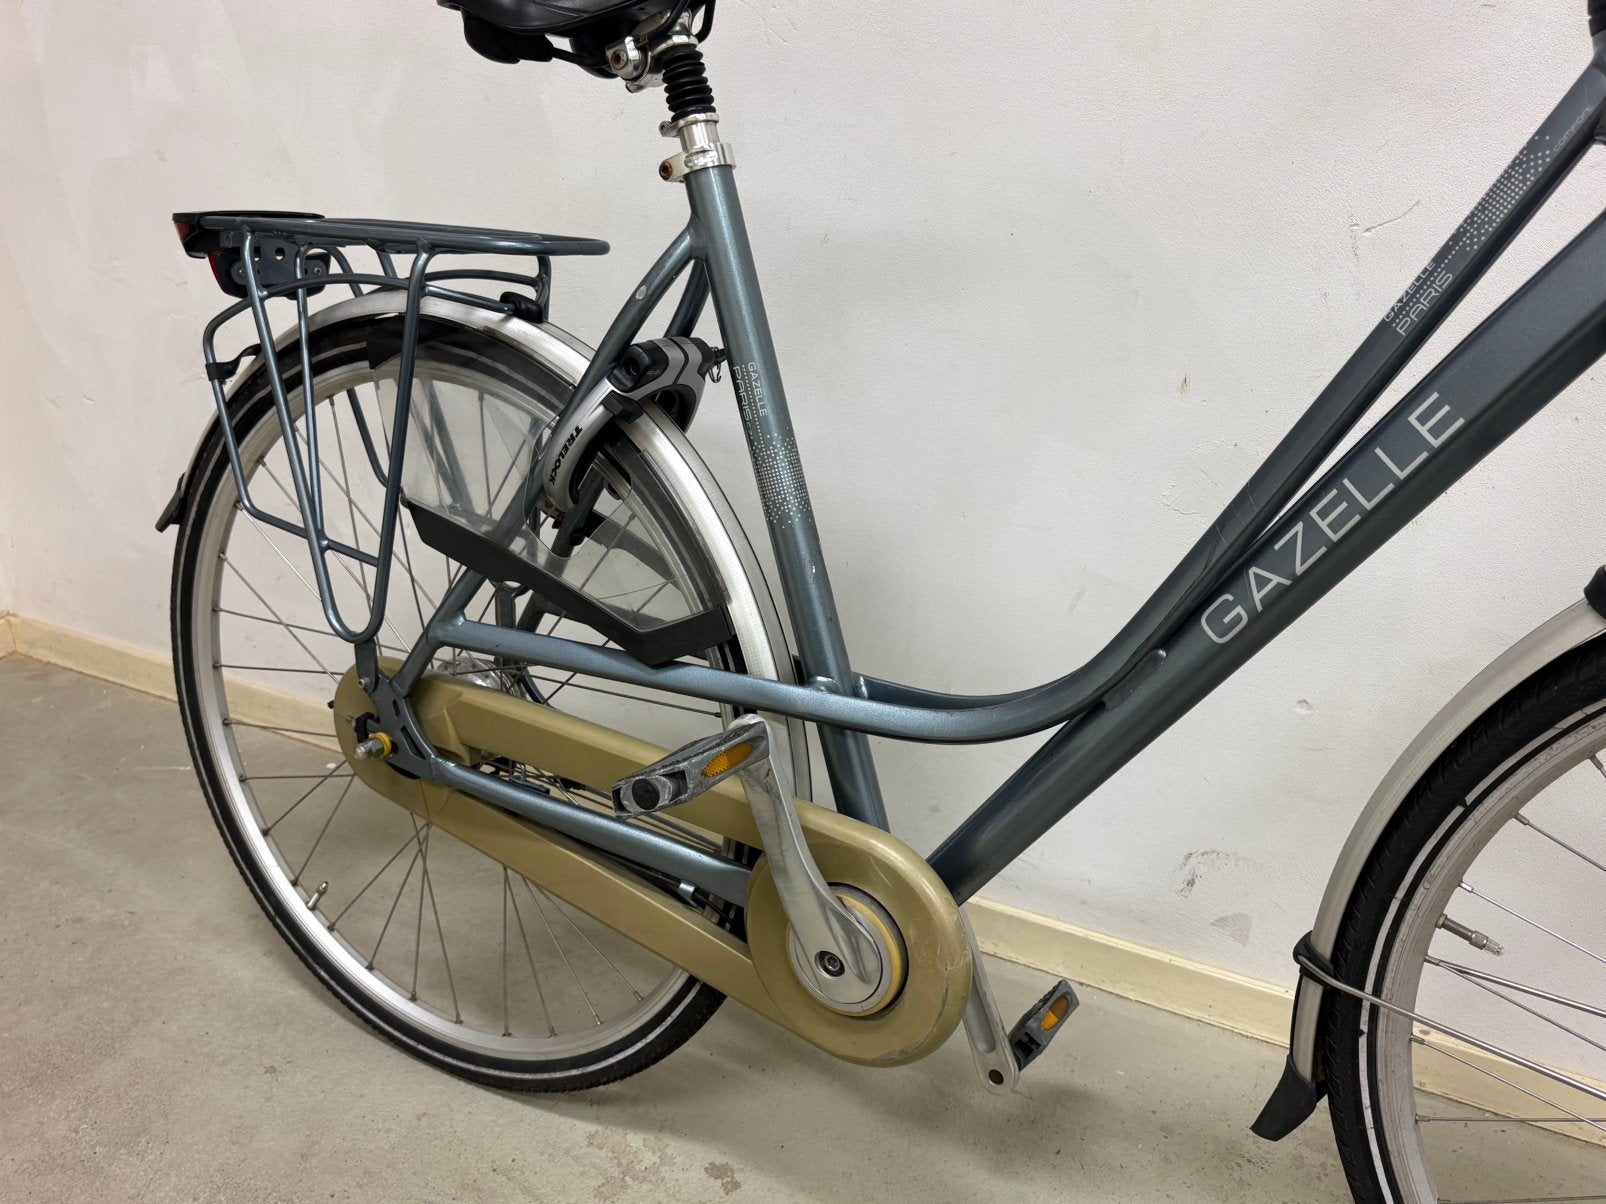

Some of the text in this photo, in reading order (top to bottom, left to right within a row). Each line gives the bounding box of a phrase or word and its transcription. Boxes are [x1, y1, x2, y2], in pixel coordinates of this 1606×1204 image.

[1384, 261, 1436, 322] GAZELLE
[1396, 271, 1453, 336] PARIS
[732, 366, 752, 421] PARIS
[748, 361, 768, 417] GAZELLE
[549, 425, 583, 486] TRELOCK
[1201, 392, 1466, 643] GAZELLE
